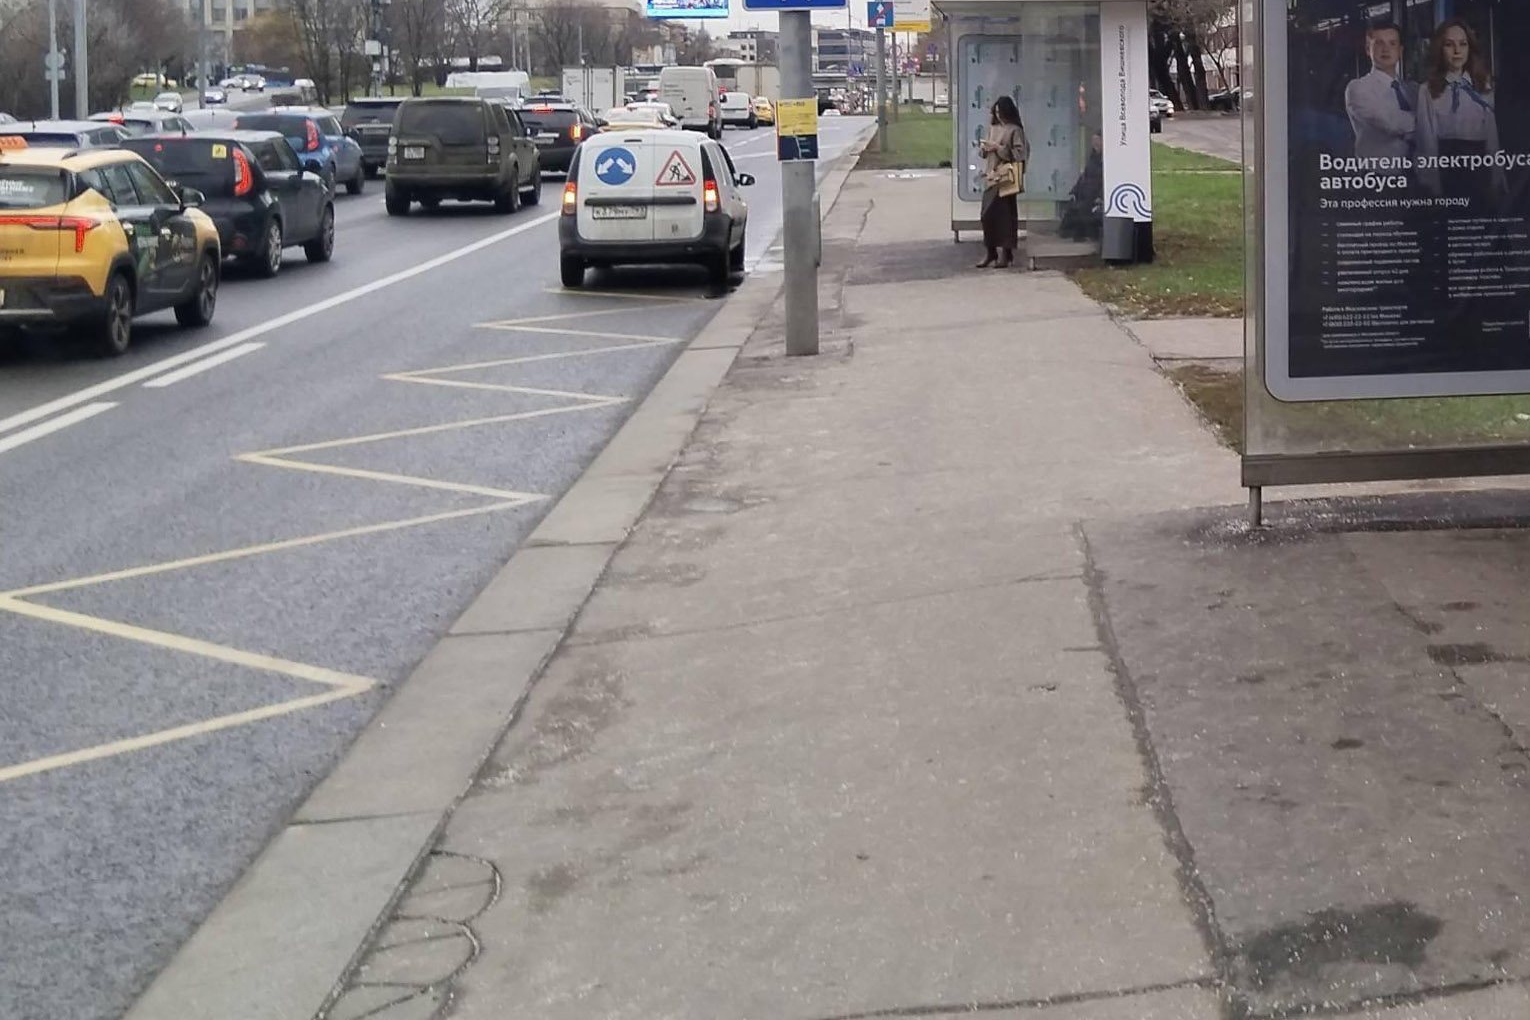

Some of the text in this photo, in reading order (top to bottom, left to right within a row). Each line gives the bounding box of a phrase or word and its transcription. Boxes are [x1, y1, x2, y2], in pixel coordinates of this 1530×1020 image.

[1119, 122, 1127, 147] Улица
[1319, 153, 1413, 173] Водитель
[1320, 172, 1408, 192] автобуса
[1319, 195, 1470, 210] Эта профессия нужна городу
